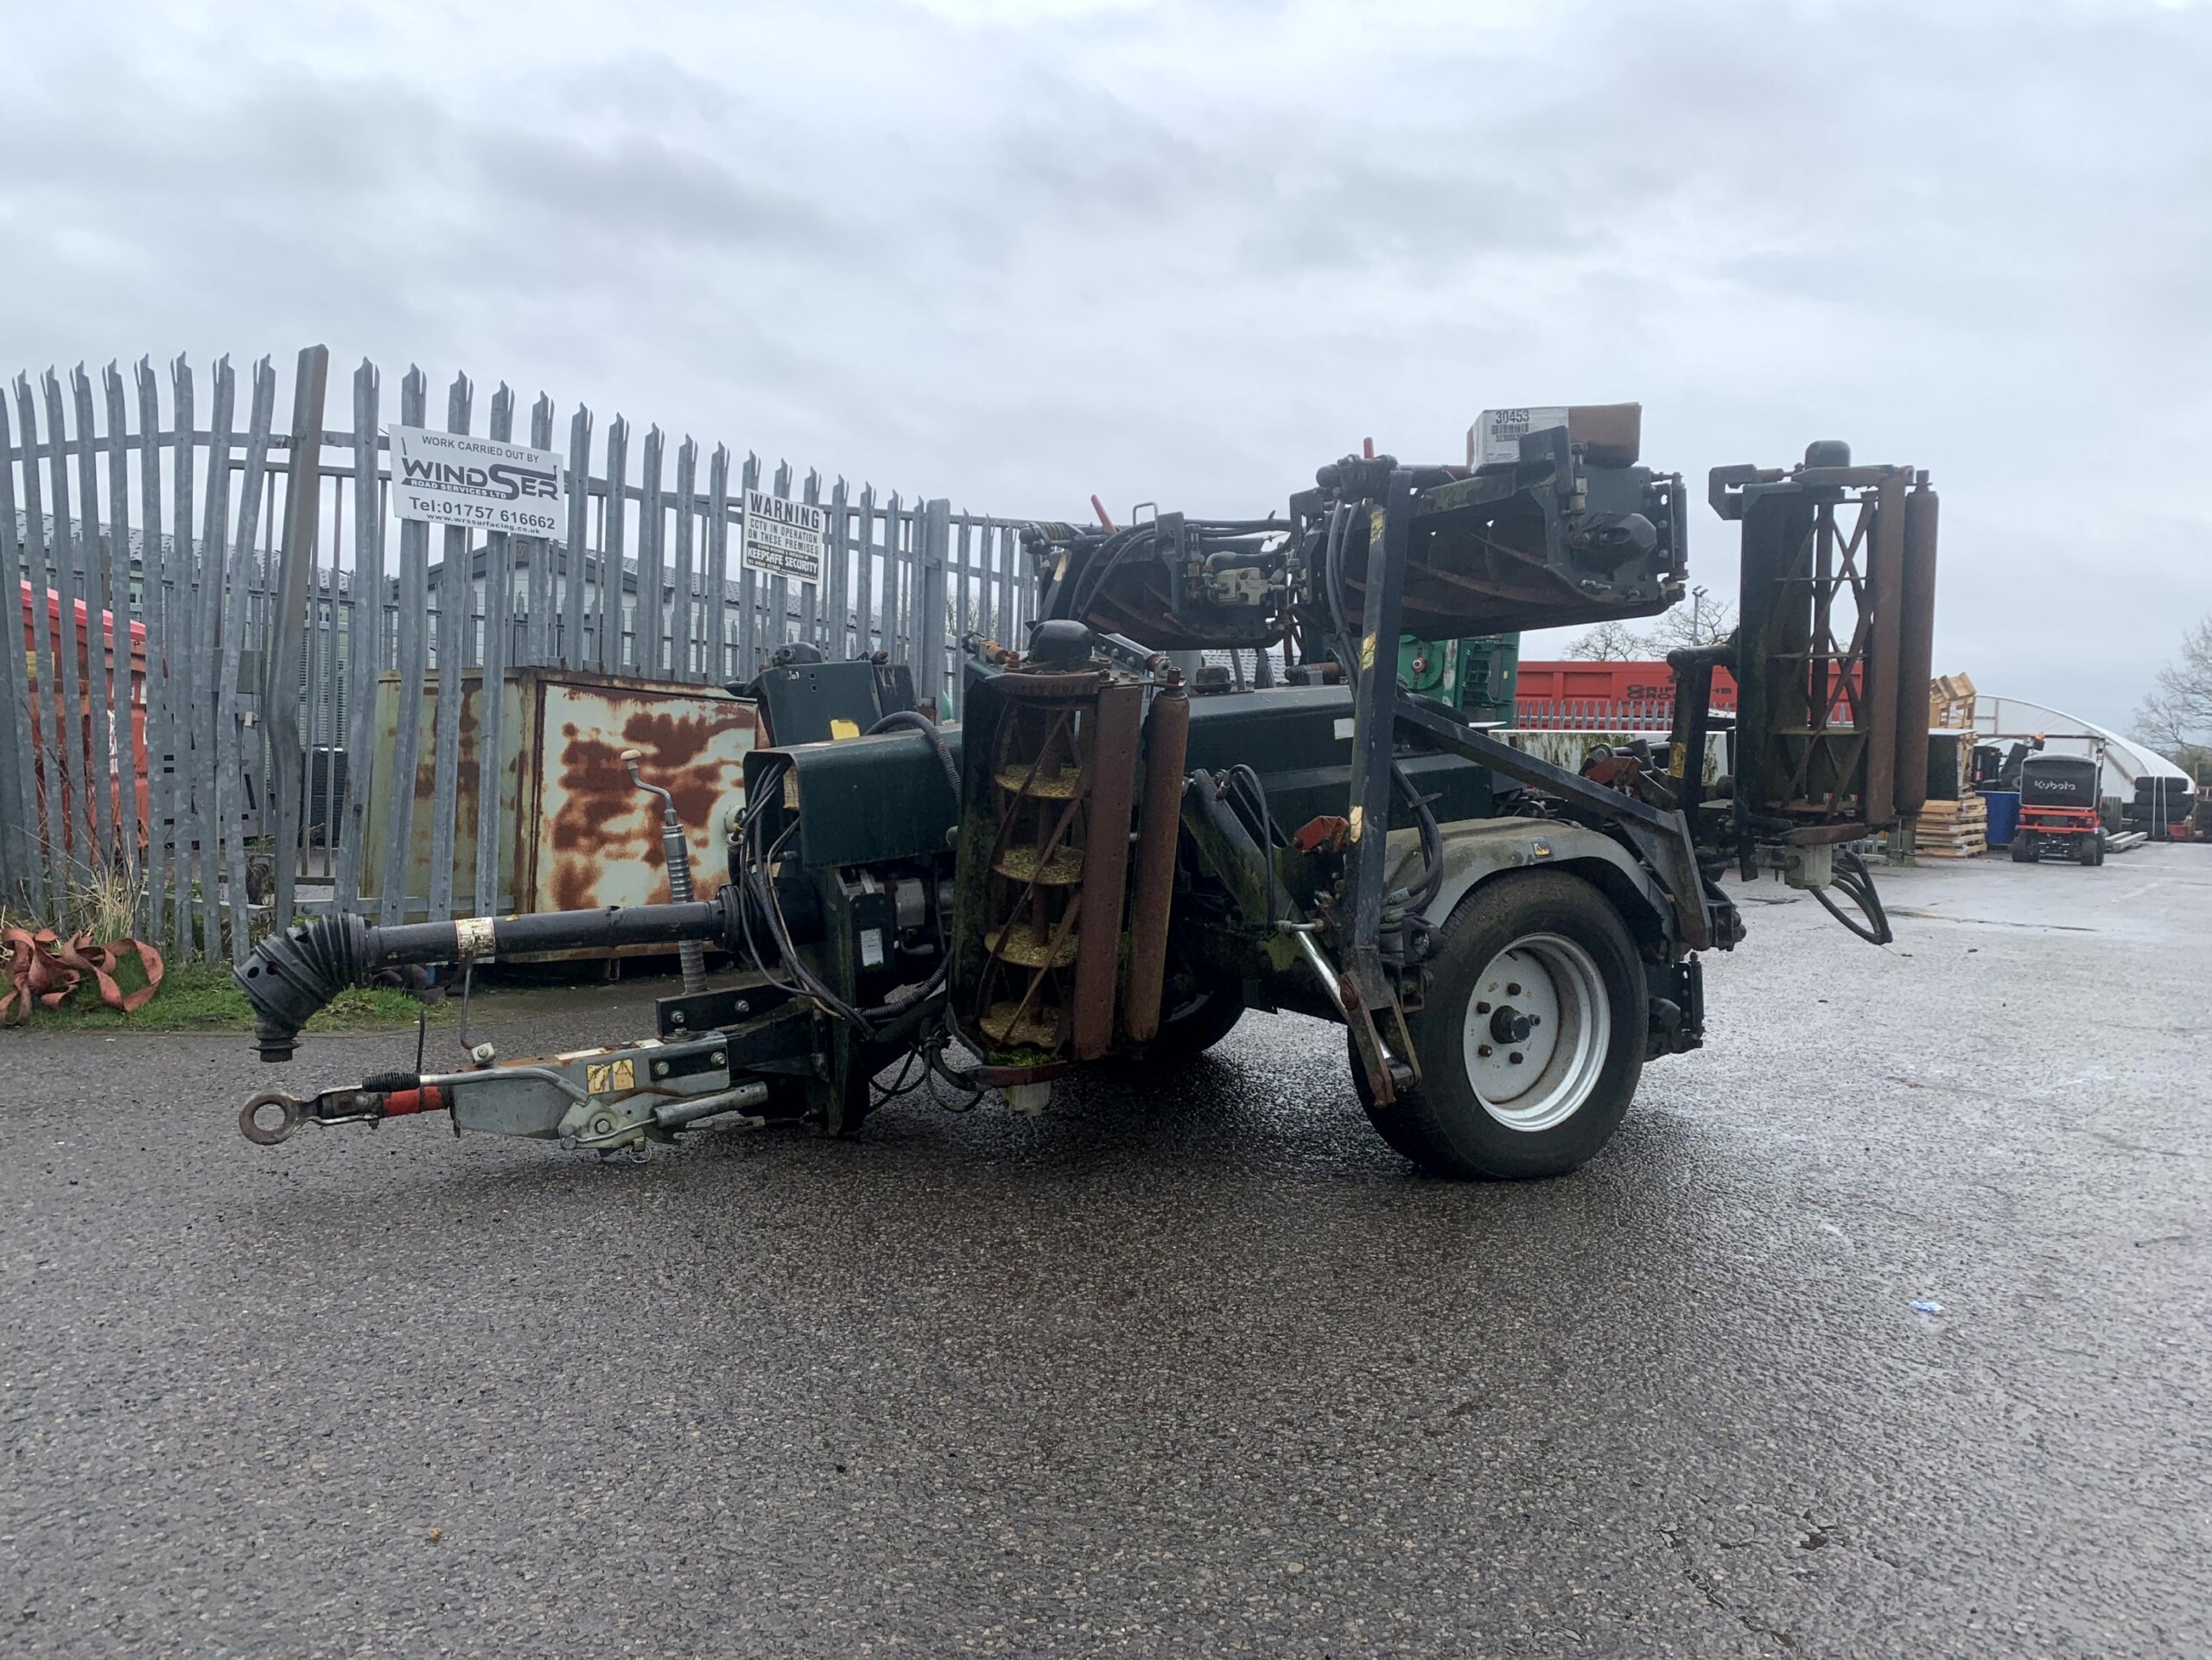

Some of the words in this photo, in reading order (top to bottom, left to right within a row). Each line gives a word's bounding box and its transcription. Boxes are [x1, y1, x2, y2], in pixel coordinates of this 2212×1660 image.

[1496, 410, 1529, 423] 30453
[422, 435, 454, 448] WORK
[458, 441, 503, 456] CARRIED
[505, 449, 524, 461] OUT
[527, 453, 539, 463] BY
[401, 457, 560, 501] WINDSER
[411, 479, 438, 489] ROAD
[441, 484, 487, 497] SERVICES
[490, 491, 507, 499] LTD
[409, 496, 494, 519] Tel:01757
[500, 510, 556, 530] 616662
[426, 513, 540, 534] www.wrssurfacing.co.uk
[750, 493, 819, 529] WARNING
[747, 528, 757, 540] ON
[760, 531, 781, 546] THESE
[785, 538, 818, 556] PREMISES
[750, 518, 767, 531] CCTV
[770, 523, 778, 534] IN
[780, 526, 817, 544] OPERATION
[747, 546, 783, 565] KEEPSAFE
[785, 556, 817, 574] SECURITY
[2034, 780, 2075, 790] Kubota
